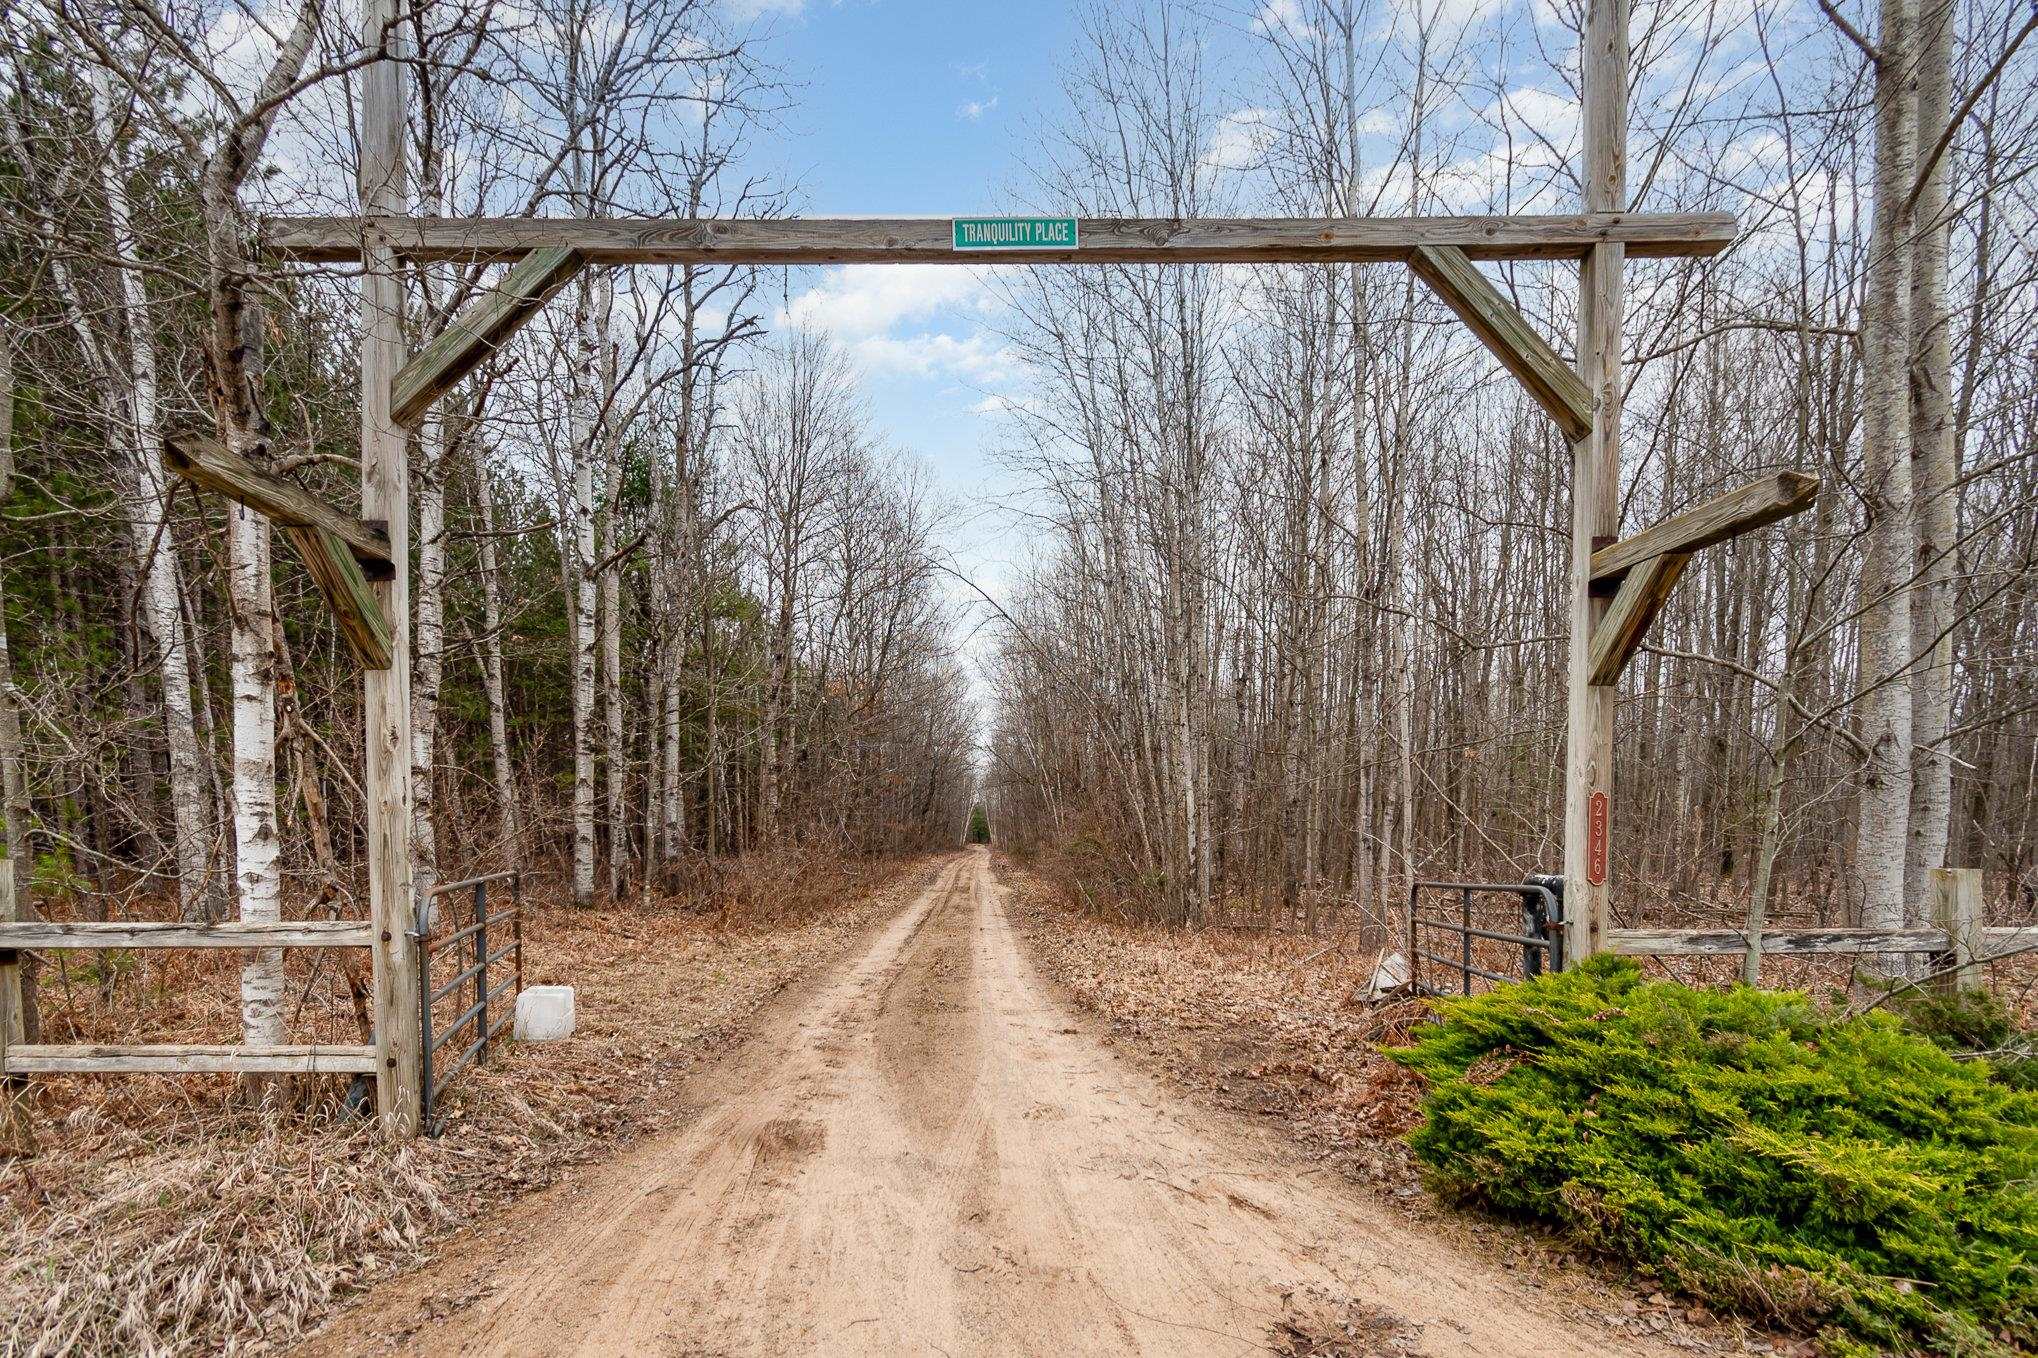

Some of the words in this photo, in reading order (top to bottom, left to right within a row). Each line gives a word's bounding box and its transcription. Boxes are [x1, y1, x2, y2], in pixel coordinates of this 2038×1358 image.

[962, 222, 1031, 244] TRANQUILITY
[1035, 222, 1069, 241] PLACE
[1594, 800, 1603, 875] 2346
